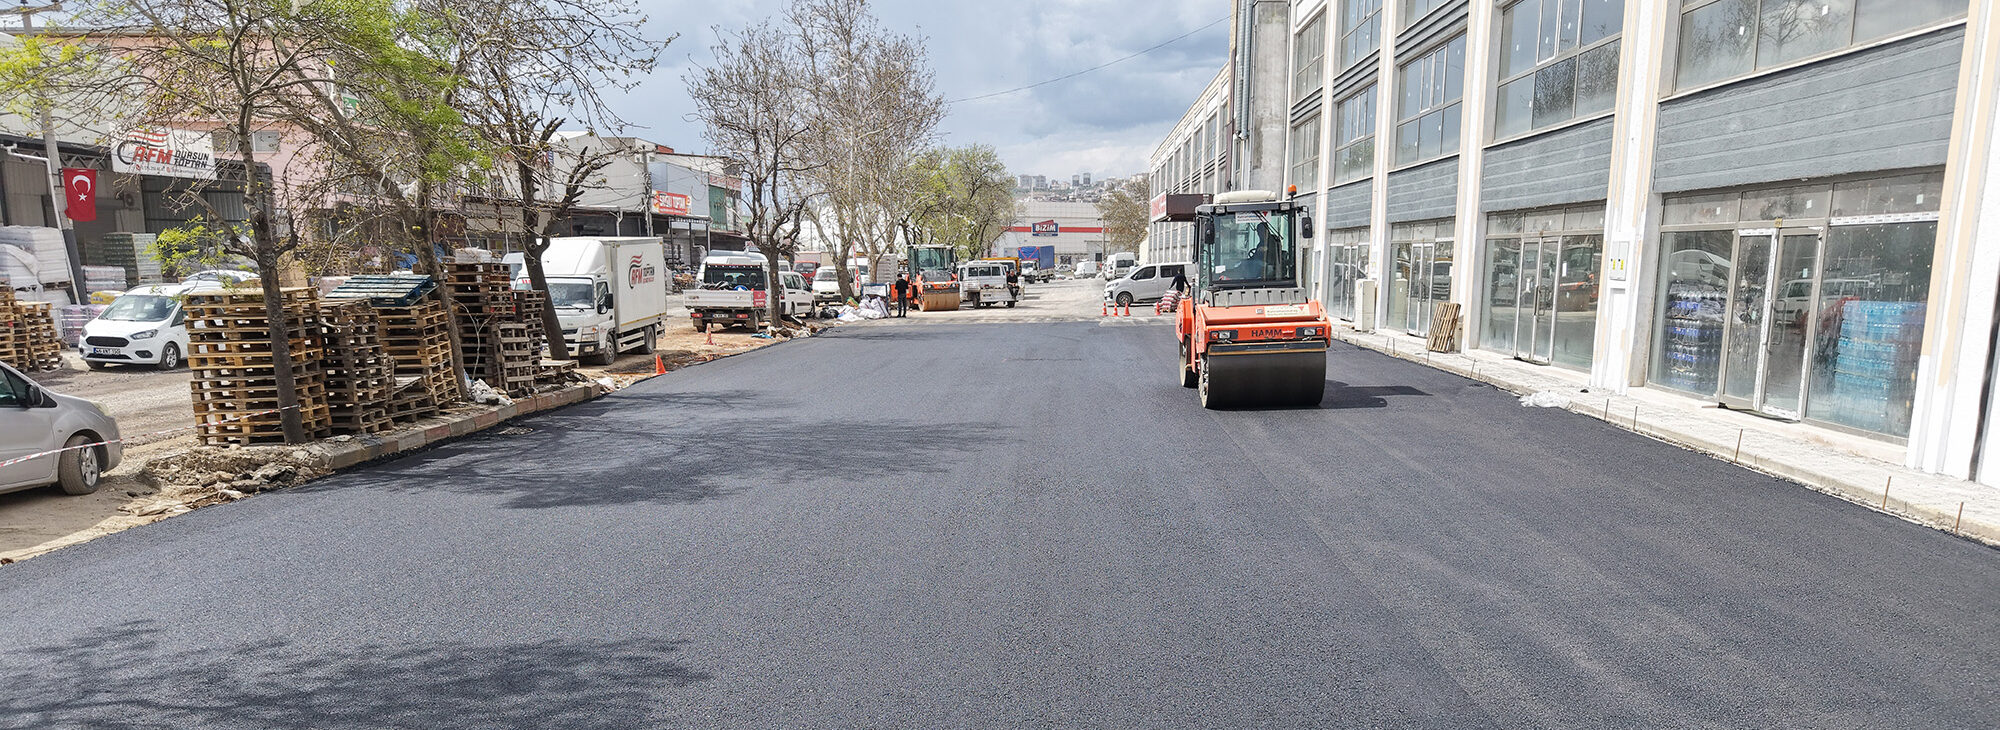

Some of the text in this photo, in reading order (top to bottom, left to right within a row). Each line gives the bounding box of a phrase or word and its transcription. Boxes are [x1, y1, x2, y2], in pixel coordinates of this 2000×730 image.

[132, 146, 173, 165] AFM
[174, 149, 210, 161] DURSUN
[174, 158, 208, 169] TOPTAN
[1251, 329, 1282, 337] HAMM
